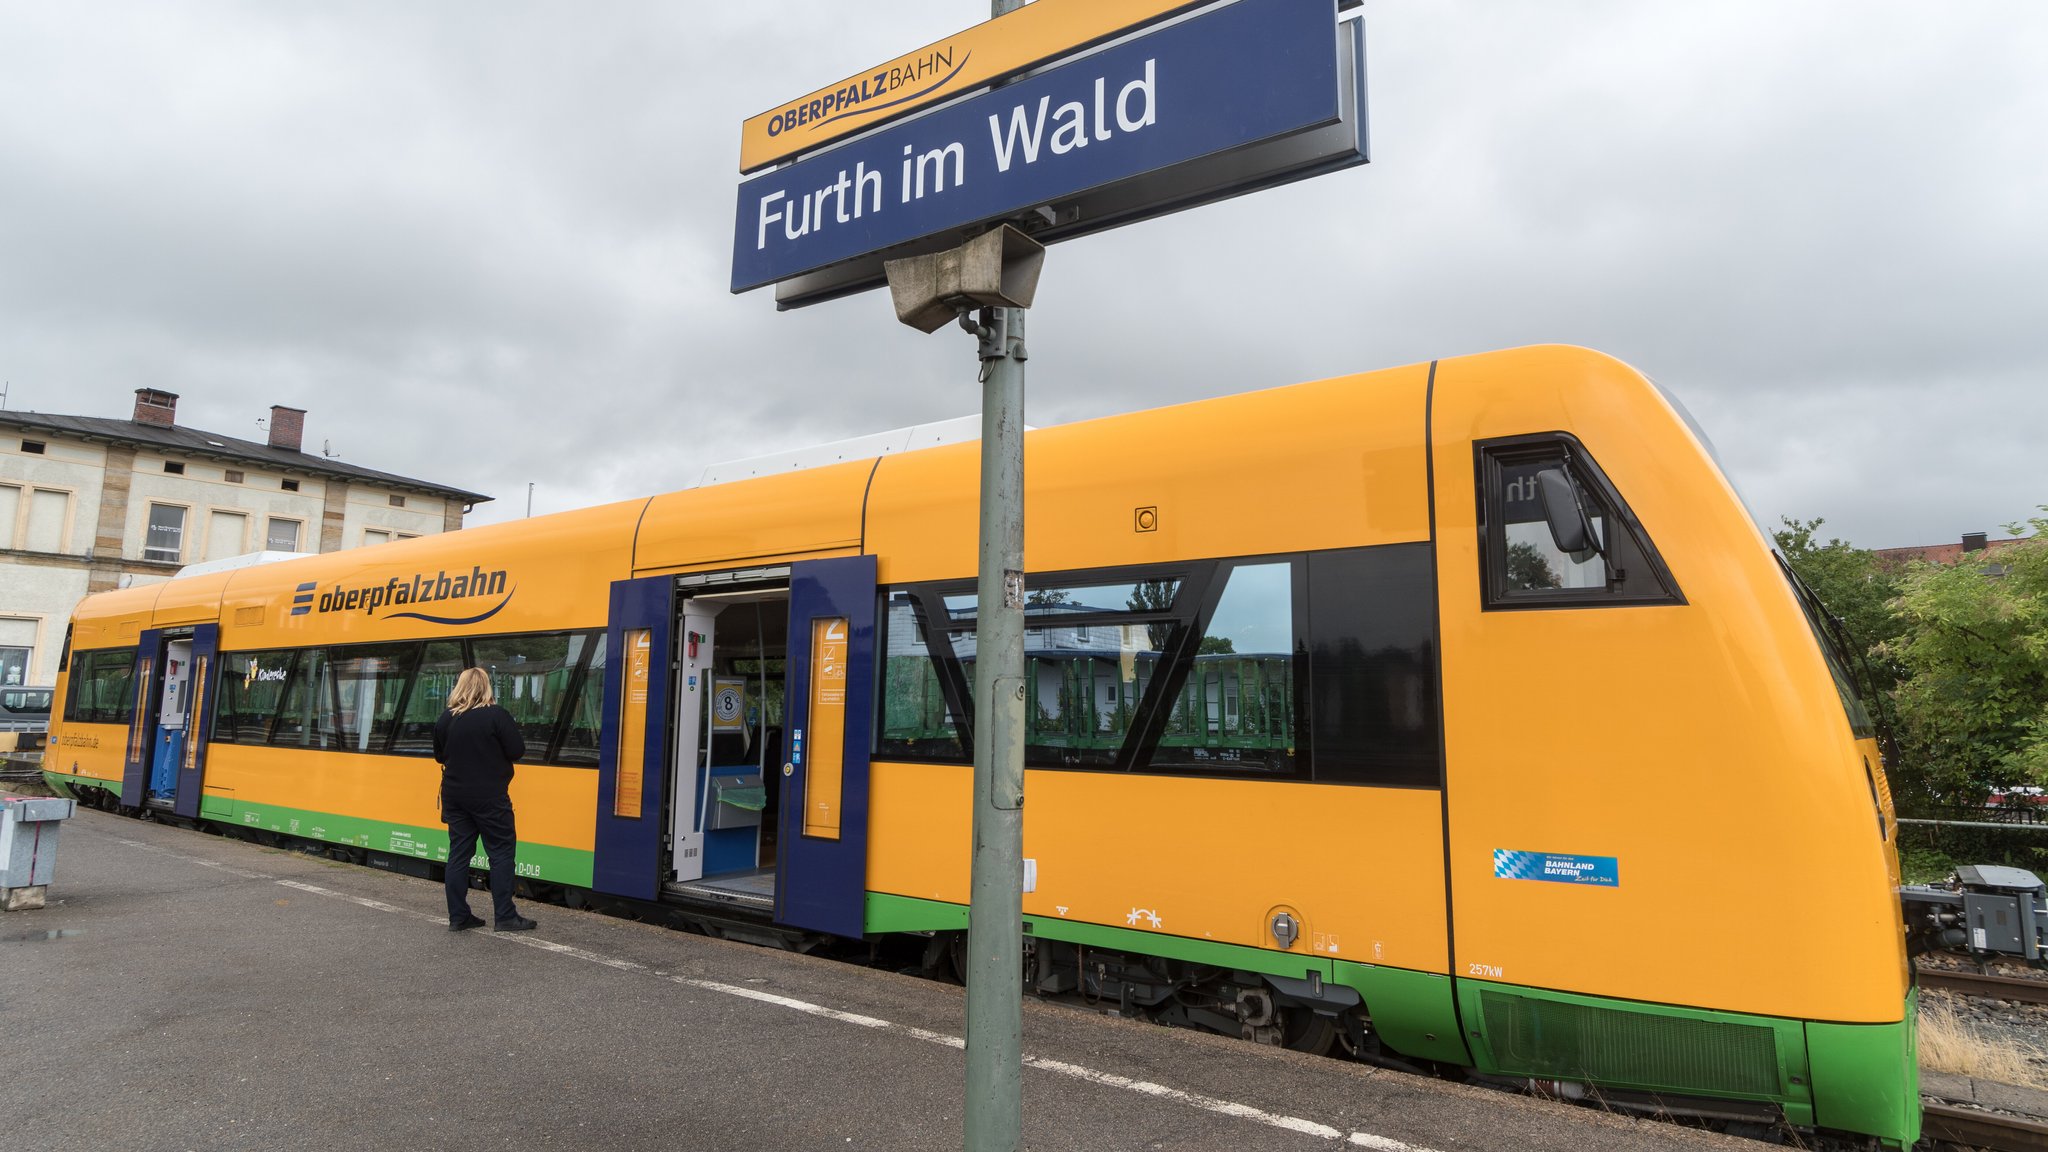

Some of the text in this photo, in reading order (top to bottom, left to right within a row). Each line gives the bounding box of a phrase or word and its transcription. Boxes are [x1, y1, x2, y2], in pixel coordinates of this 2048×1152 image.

[767, 46, 953, 137] OBERPFALZBAHN
[757, 58, 1157, 250] Furth im Wald
[318, 565, 507, 616] oberpfalzbahn
[724, 696, 733, 711] 8
[518, 862, 541, 877] D-DLB
[1544, 867, 1580, 876] BAYERN
[1545, 860, 1595, 871] BAHNLAND
[1469, 963, 1503, 978] 257kW
